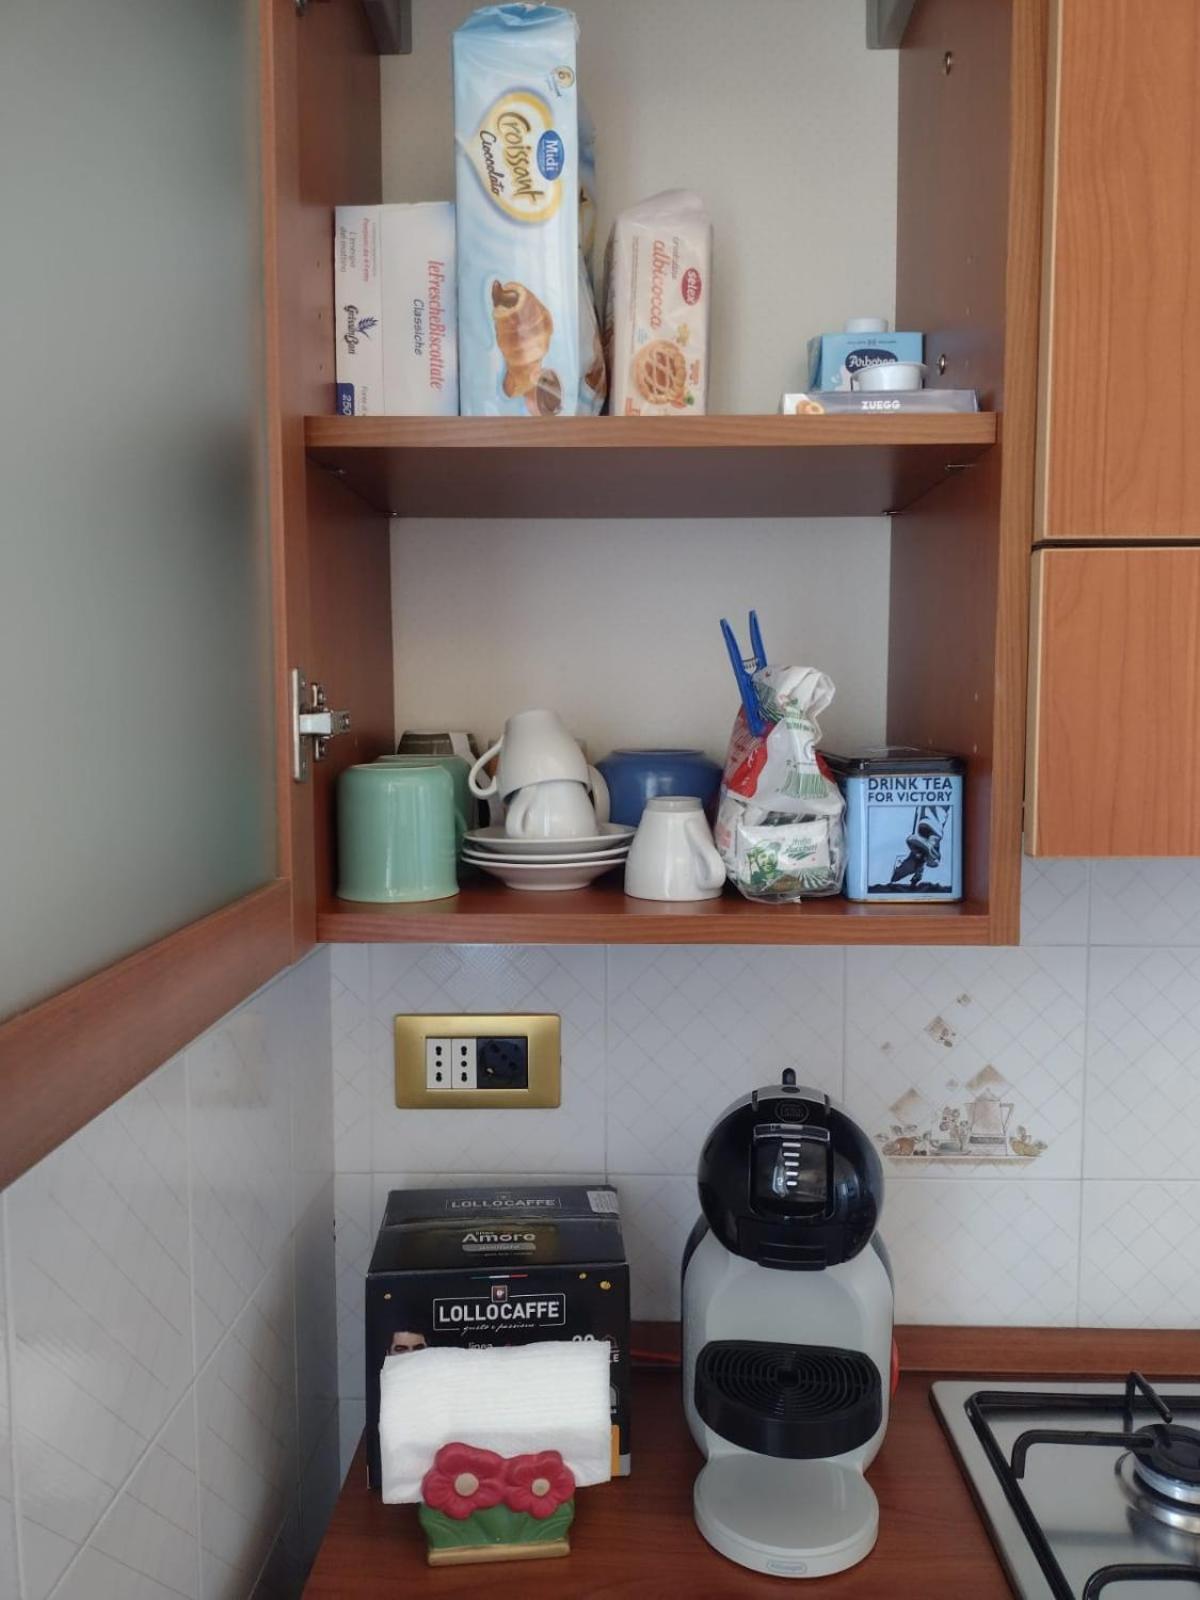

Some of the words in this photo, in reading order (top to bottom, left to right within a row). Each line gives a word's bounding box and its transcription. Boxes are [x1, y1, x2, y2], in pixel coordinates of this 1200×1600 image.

[479, 130, 505, 195] Cioccolato
[497, 112, 544, 203] Croissant
[544, 139, 559, 171] Midi
[650, 240, 671, 330] albicocca
[686, 269, 698, 304] selex
[413, 298, 425, 356] Classiche
[861, 400, 900, 410] ZUEGG
[868, 777, 918, 790] DRINK
[923, 777, 952, 790] TEA
[868, 792, 893, 802] FOR
[897, 791, 952, 802] VICTORY
